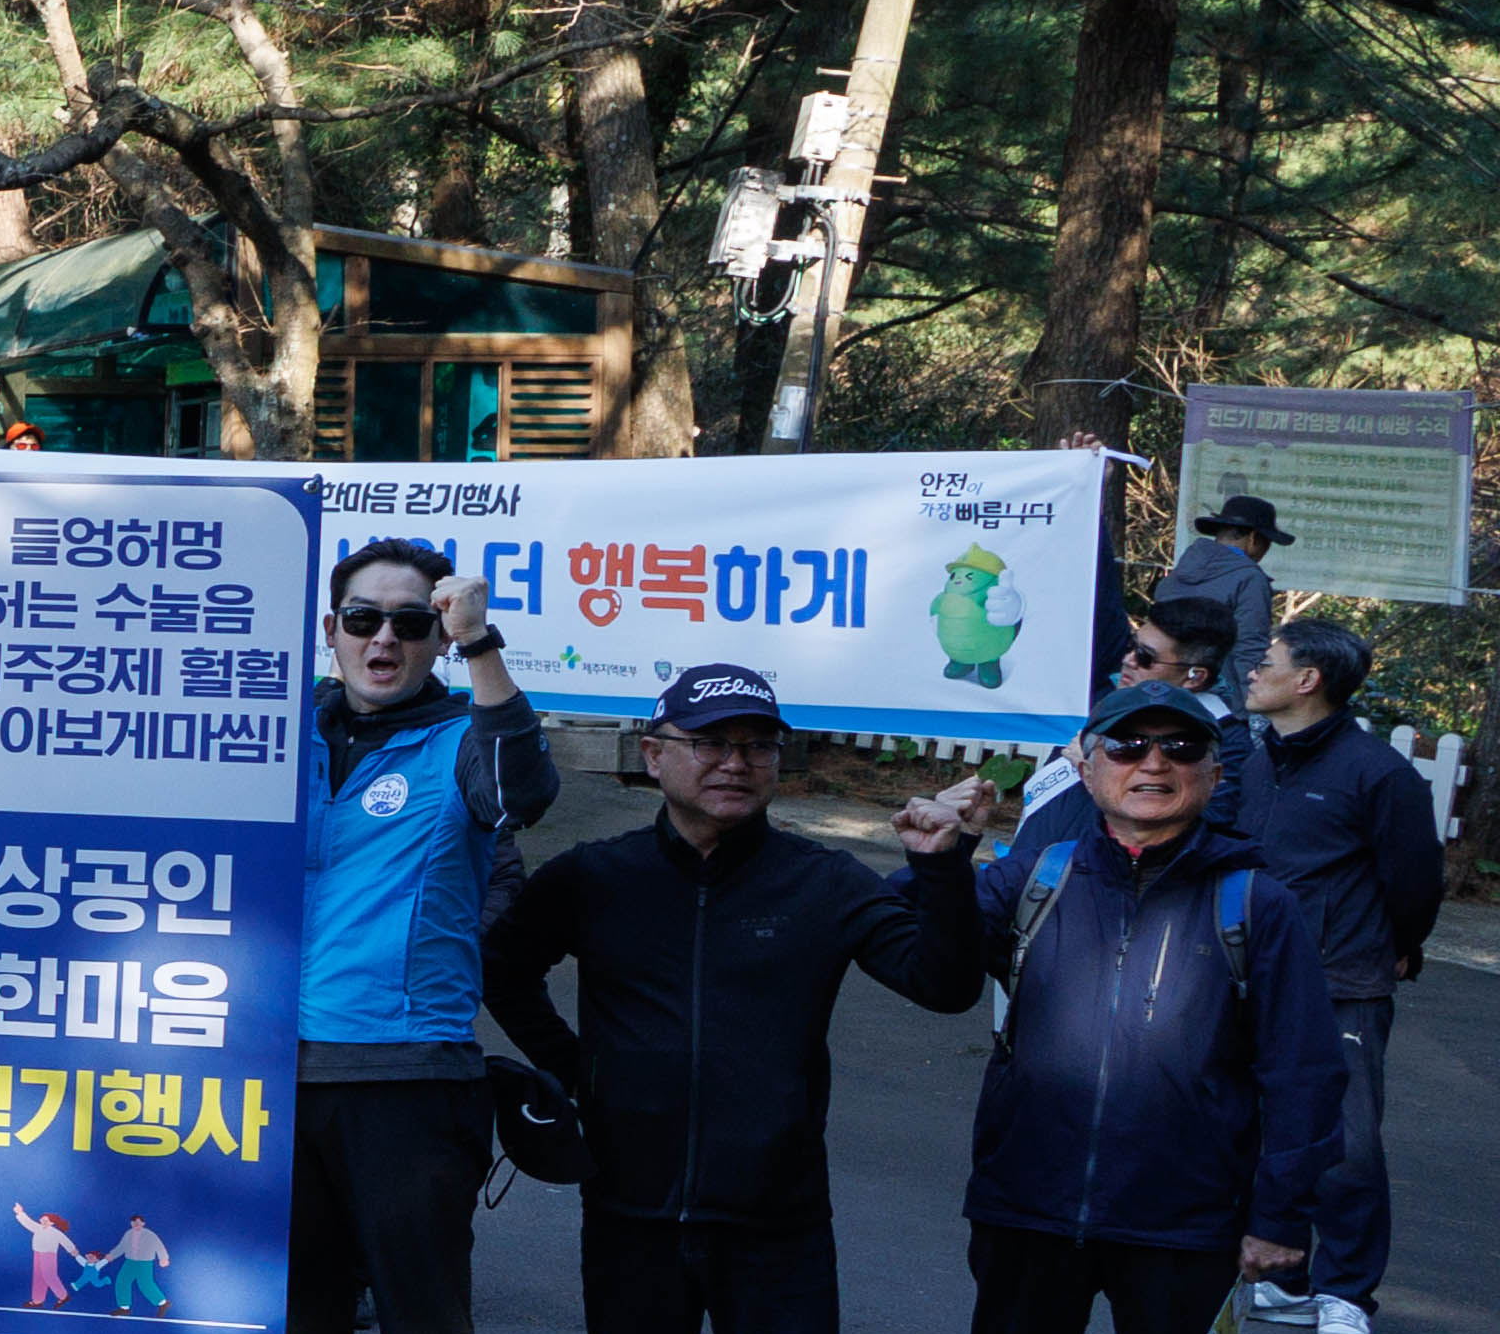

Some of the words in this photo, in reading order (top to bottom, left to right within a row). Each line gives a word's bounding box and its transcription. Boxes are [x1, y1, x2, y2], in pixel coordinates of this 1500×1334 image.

[405, 482, 521, 517] 걷기행사
[919, 471, 983, 498] 안전이
[917, 502, 951, 522] 가장
[955, 500, 1056, 530] 빠릅니다
[10, 517, 223, 570] 들엉허멍
[483, 540, 543, 615] 더
[567, 541, 868, 628] 행복하게
[95, 583, 255, 635] 수눌음
[179, 647, 289, 700] 훨훨
[689, 676, 774, 704] Titleist
